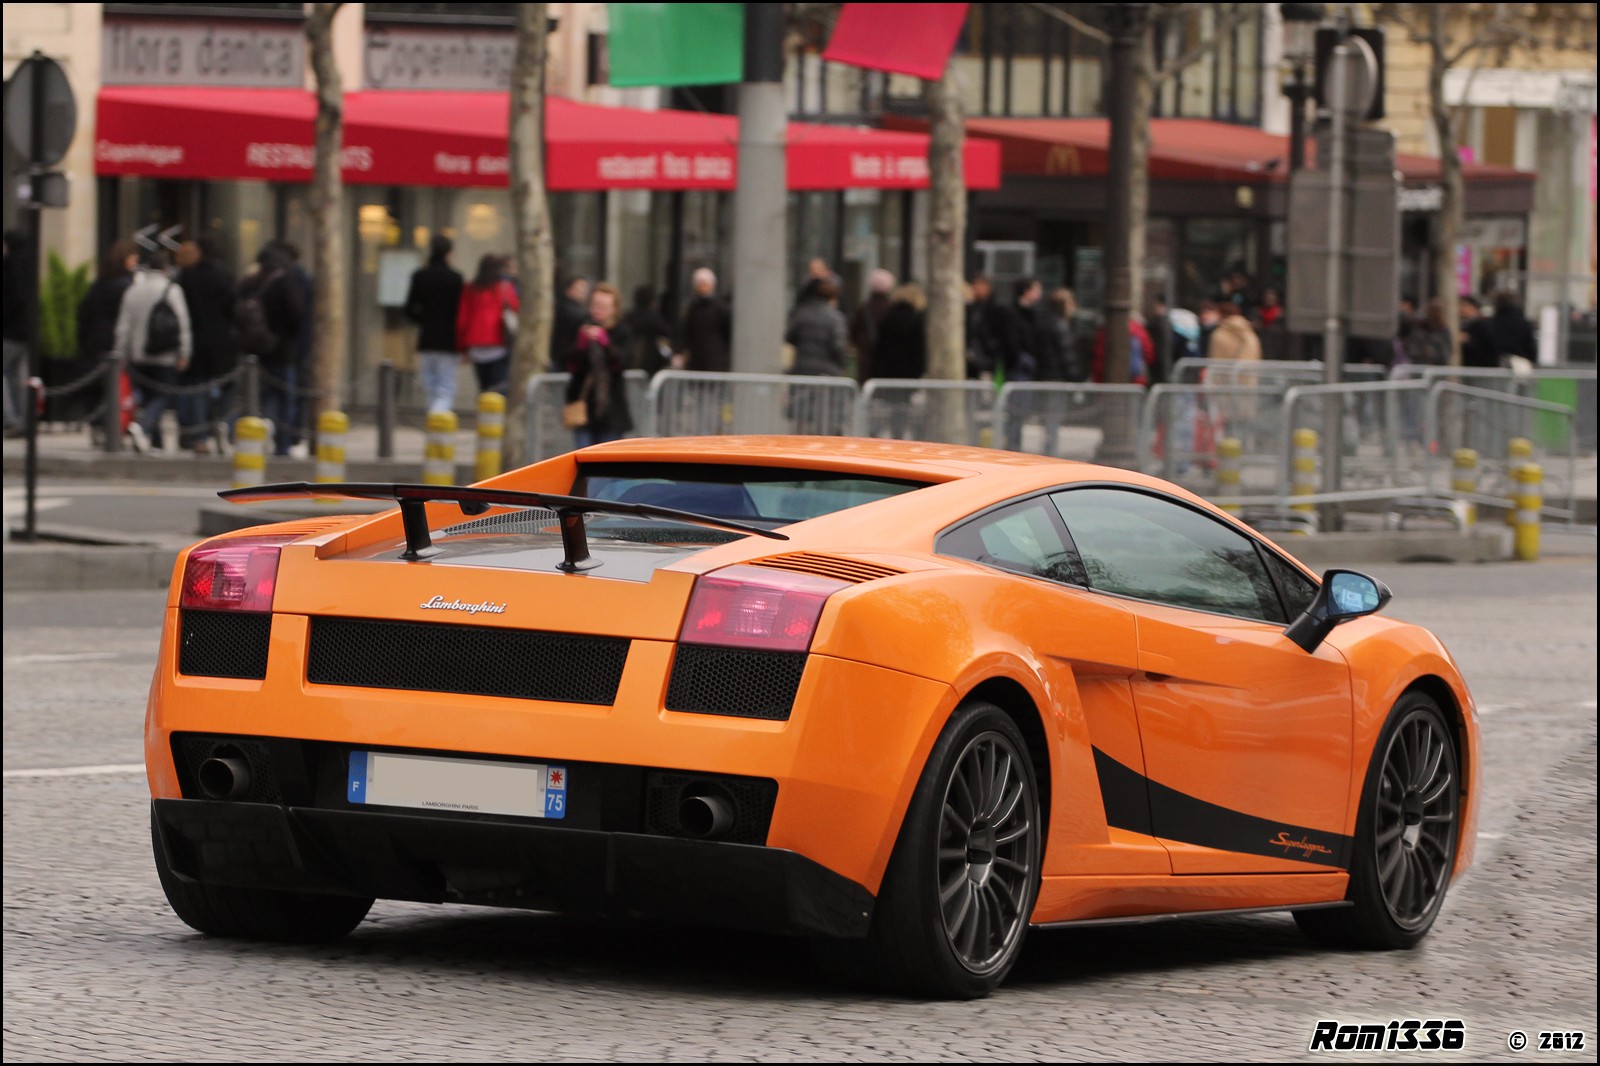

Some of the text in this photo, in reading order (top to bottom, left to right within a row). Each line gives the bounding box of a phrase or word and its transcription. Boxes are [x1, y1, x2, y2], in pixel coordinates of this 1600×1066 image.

[363, 27, 513, 89] Copenhag
[420, 595, 507, 615] Lamborghini
[352, 781, 360, 792] F
[421, 801, 461, 809] LAMBORGHINI
[547, 793, 563, 812] 75
